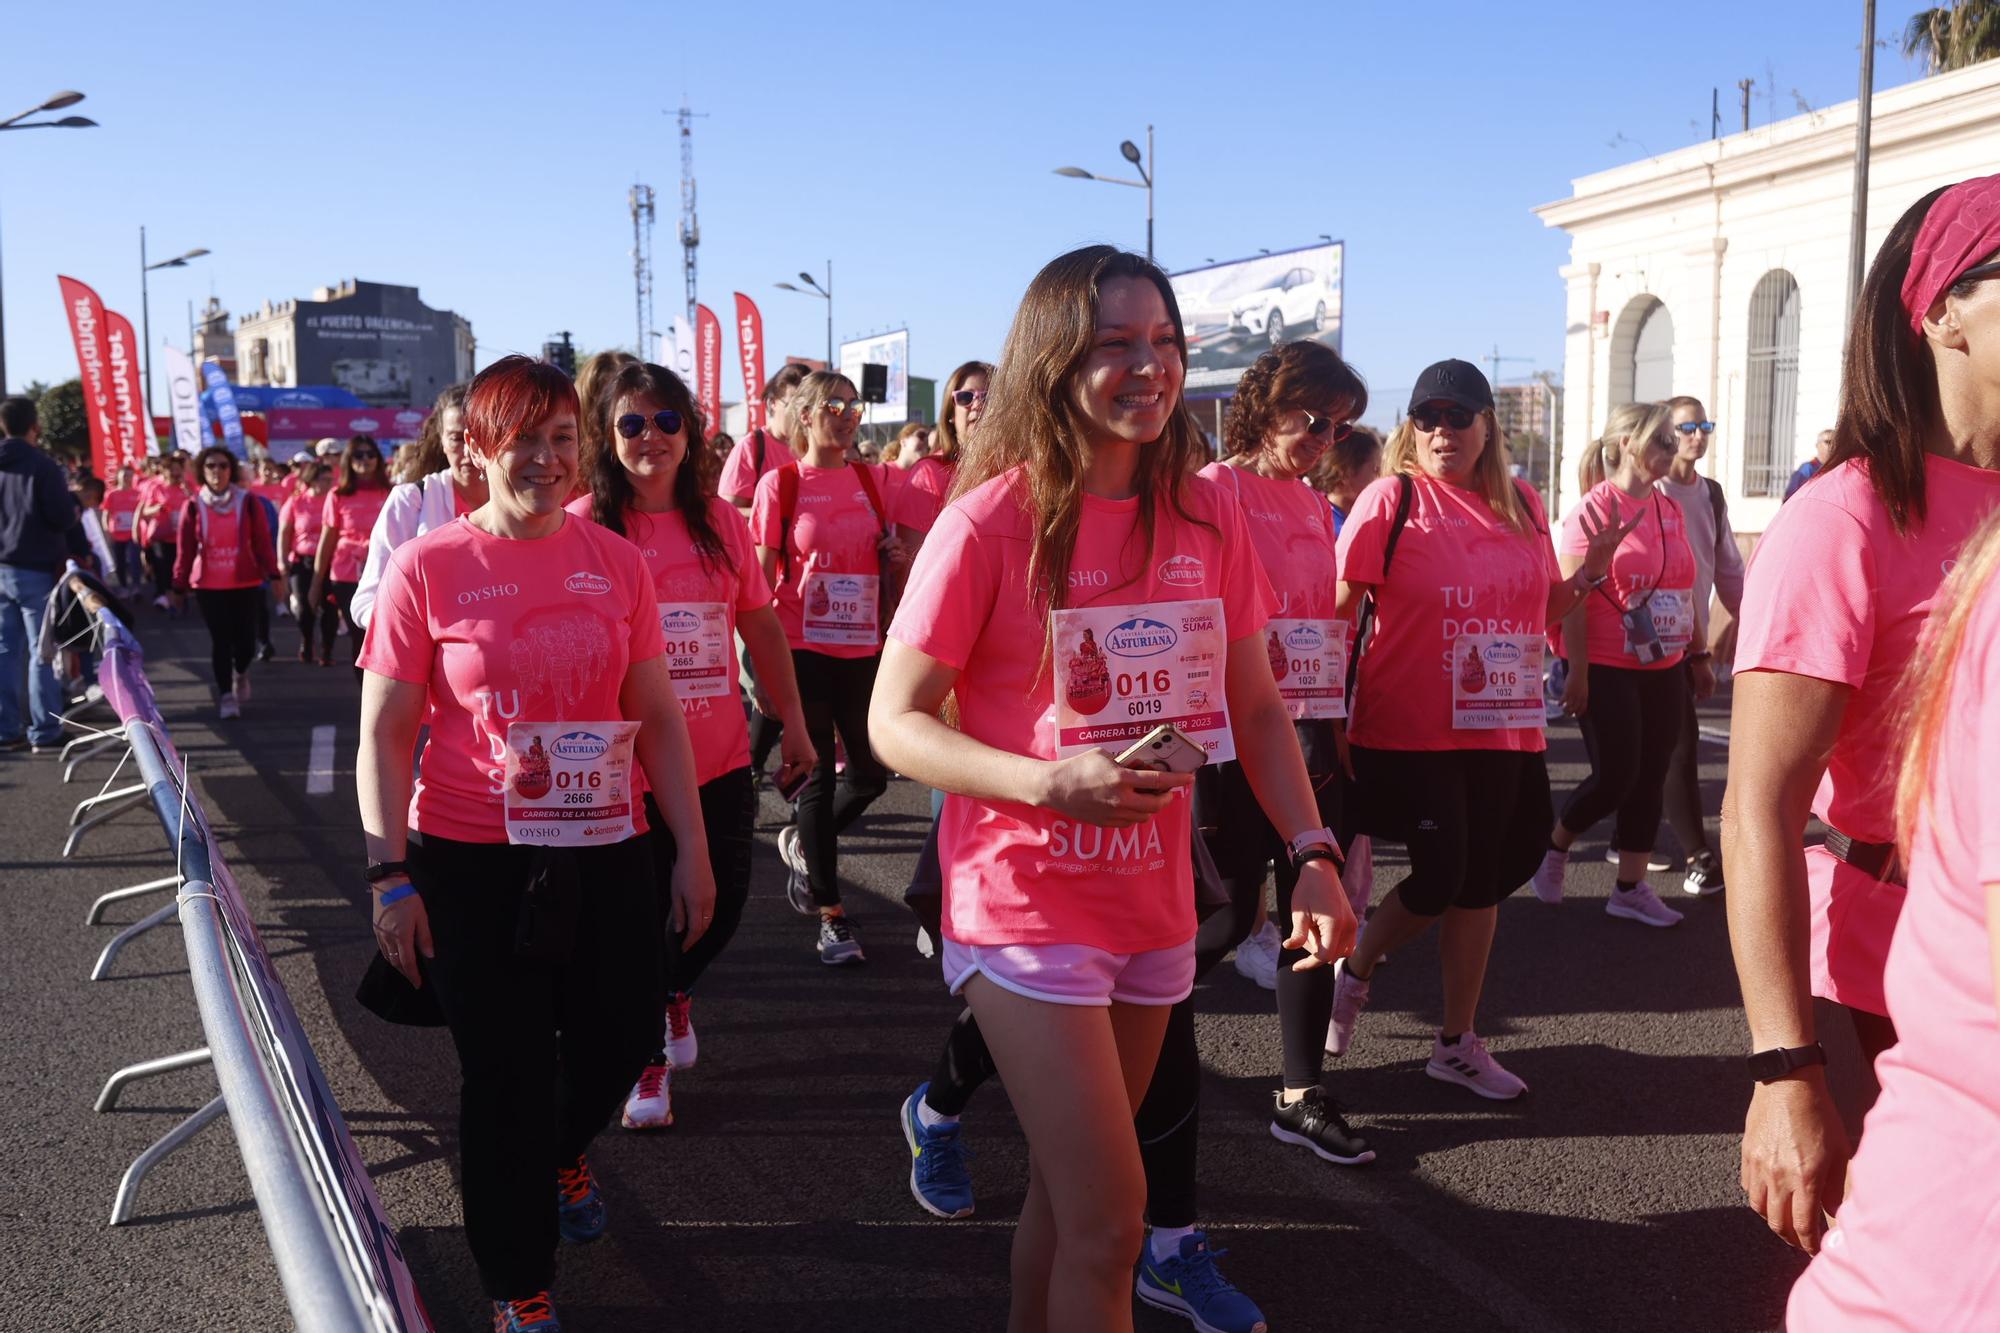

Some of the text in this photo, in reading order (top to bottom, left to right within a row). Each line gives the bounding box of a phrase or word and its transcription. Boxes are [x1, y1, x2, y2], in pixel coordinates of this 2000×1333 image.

[457, 583, 519, 605] OYSHO
[1440, 586, 1473, 609] TU
[832, 601, 857, 613] 016
[1182, 621, 1214, 632] SUMA
[665, 640, 700, 655] 016
[1111, 632, 1173, 650] ASTURIANA
[672, 657, 694, 667] 2665
[1291, 658, 1321, 673] 016
[1116, 669, 1171, 697] 016
[1489, 671, 1517, 685] 016
[1495, 688, 1513, 696] 1032
[475, 689, 520, 721] TU
[1128, 699, 1162, 716] 6019
[1463, 714, 1495, 722] OYSHO
[1078, 727, 1126, 740] CARRERA
[1129, 727, 1142, 735] DE
[1191, 717, 1212, 728] 2023
[553, 742, 605, 754] ASTURIANA
[555, 771, 602, 789] 016
[562, 793, 594, 804] 2666
[522, 811, 560, 819] CARRERA
[587, 809, 610, 818] MUJER
[520, 827, 560, 838] OYSHO
[593, 824, 625, 836] Santander
[1049, 819, 1163, 861] SUMA
